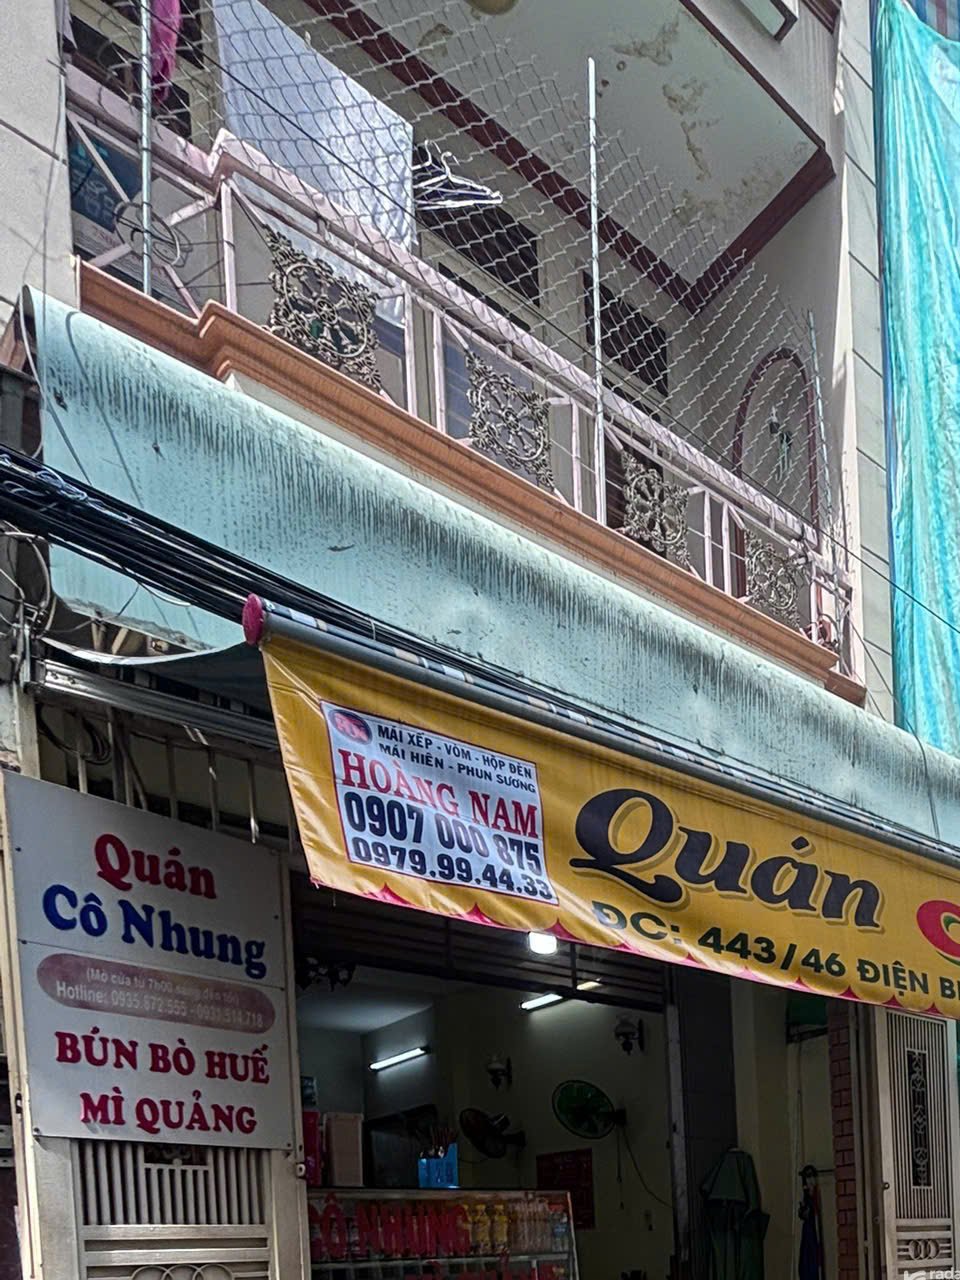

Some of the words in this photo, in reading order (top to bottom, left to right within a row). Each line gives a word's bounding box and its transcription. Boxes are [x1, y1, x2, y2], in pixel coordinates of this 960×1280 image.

[377, 724, 403, 742] MÁI
[407, 727, 433, 750] XẾP
[379, 743, 406, 761] MÁI
[410, 752, 445, 770] HIÊN
[457, 763, 493, 782] PHUN
[338, 748, 460, 819] HOÀNG
[468, 790, 540, 840] NAM
[94, 833, 217, 900] Quán
[343, 791, 425, 845] 0907
[434, 812, 490, 859] 000
[493, 833, 544, 877] 875
[569, 788, 883, 930] Quán
[351, 836, 555, 901] 0979.99.44.33
[42, 884, 108, 937] Cô
[118, 899, 268, 980] Nhung
[857, 958, 930, 998] ĐIỆN
[55, 1026, 139, 1070] BÚN
[148, 1038, 196, 1077] BÒ
[205, 1043, 270, 1085] HUẾ
[80, 1086, 126, 1126] MÌ
[135, 1089, 258, 1135] QUẢNG
